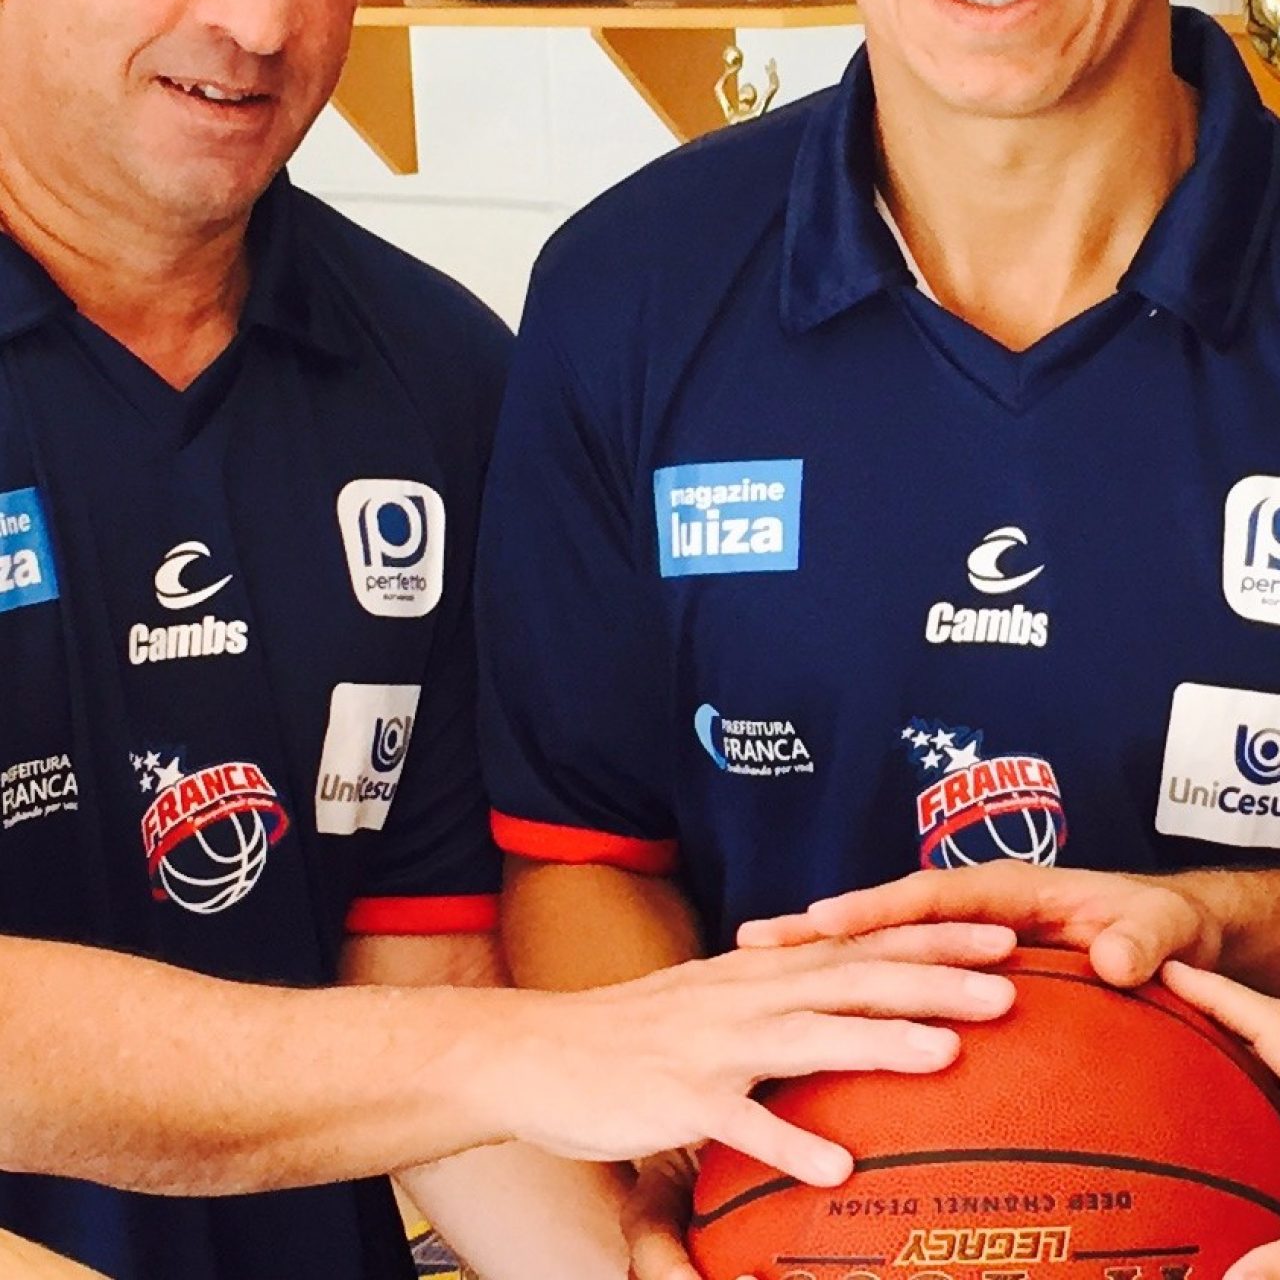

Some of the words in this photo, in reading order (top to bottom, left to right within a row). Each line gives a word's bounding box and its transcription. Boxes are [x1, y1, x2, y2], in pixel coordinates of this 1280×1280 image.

[670, 478, 785, 510] magazine
[671, 508, 784, 559] luiza
[366, 572, 427, 592] perfetto
[128, 615, 249, 666] Cambs
[925, 602, 1049, 648] Cambs
[721, 718, 796, 736] PREFEITURA
[723, 736, 811, 763] FRANCA
[141, 762, 277, 858] FRANCA
[917, 756, 1061, 835] FRANCA
[828, 1199, 919, 1217] DESIGN
[933, 1196, 1056, 1214] CHANNEL
[1068, 1191, 1133, 1211] DEEP
[893, 1225, 1071, 1266] LEGACY
